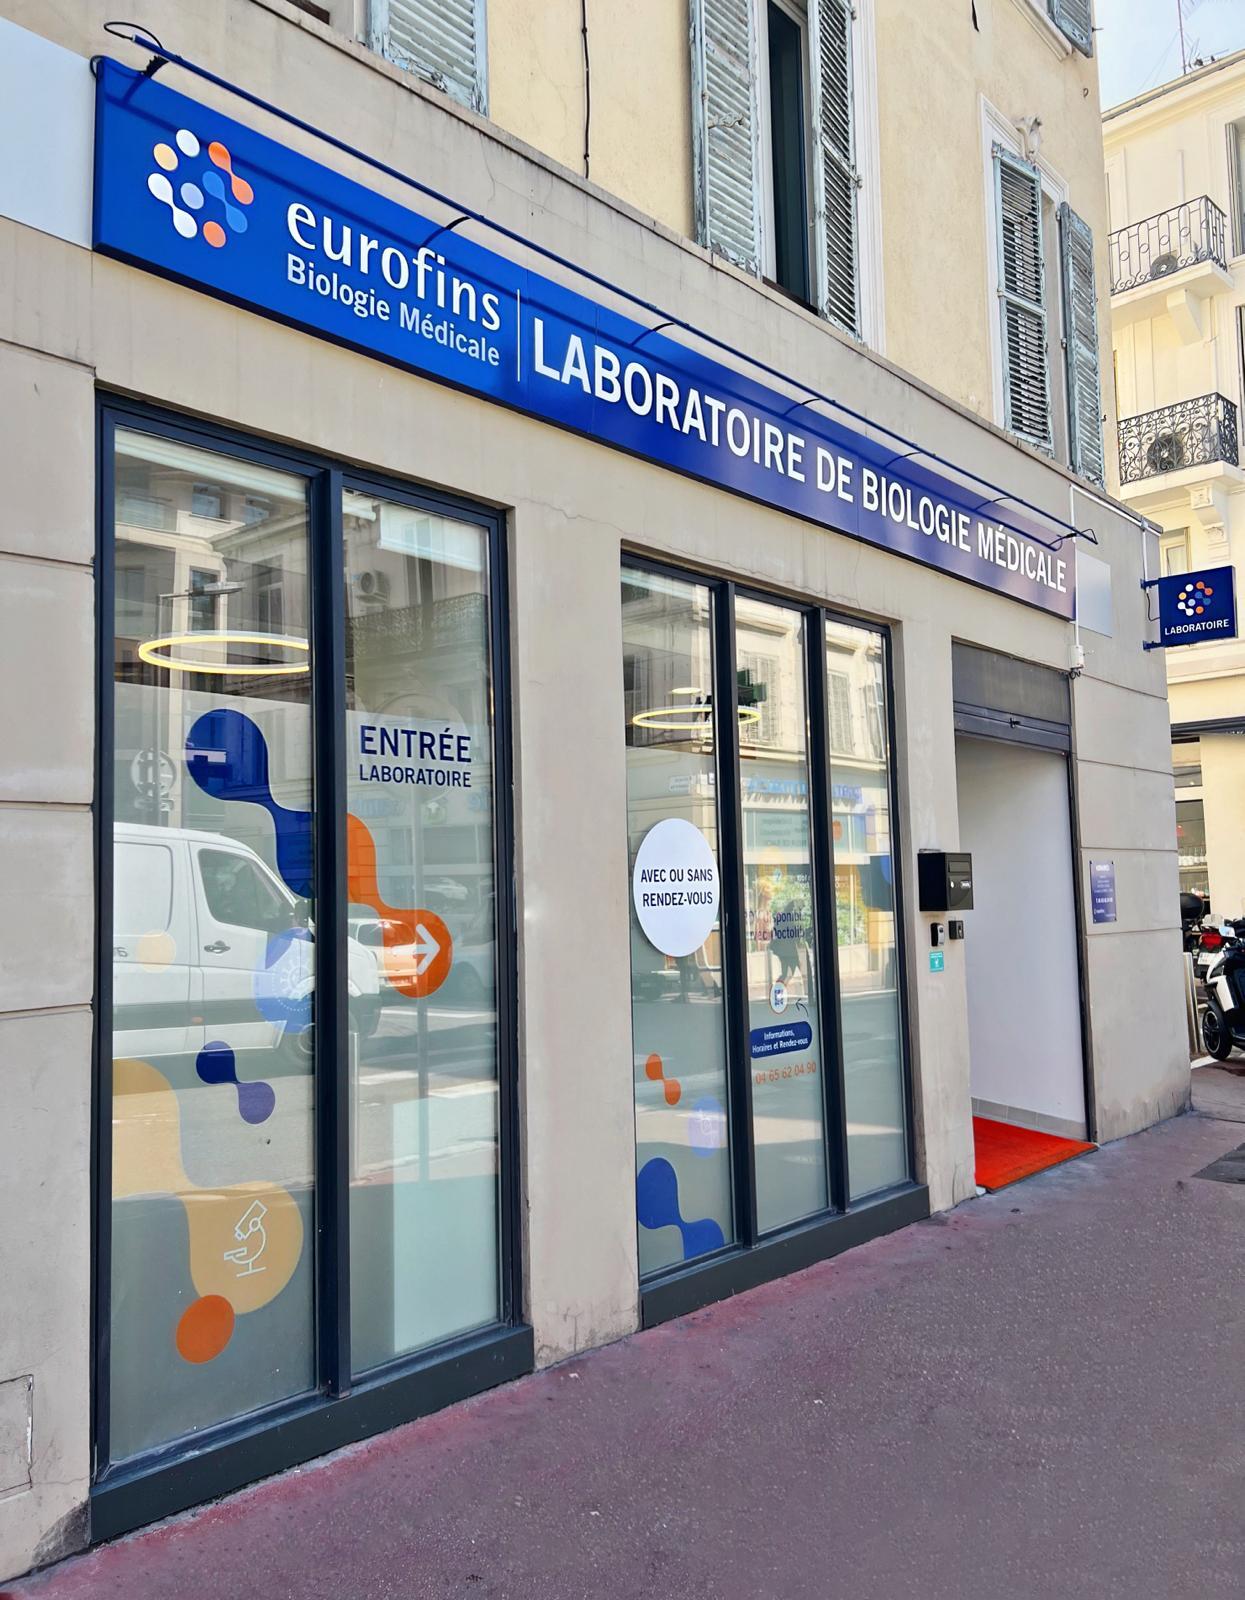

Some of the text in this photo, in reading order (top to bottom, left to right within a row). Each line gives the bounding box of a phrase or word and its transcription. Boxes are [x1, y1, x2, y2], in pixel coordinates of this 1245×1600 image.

[287, 201, 501, 332] eurofins
[286, 252, 500, 367] Biologie Médicale
[534, 317, 1067, 593] LABORATOIRE DE BIOLOGIE MÉDICALE
[1164, 618, 1230, 635] LABORATOIRE
[360, 725, 472, 763] ENTRÉE
[359, 763, 472, 788] LABORATOIRE
[640, 868, 713, 883] AVEC OU SANS
[642, 891, 713, 907] RENDEZ-VOUS
[752, 1044, 772, 1053] Horaires
[773, 1041, 779, 1050] et
[756, 1072, 766, 1084] 04
[769, 1069, 779, 1082] 65
